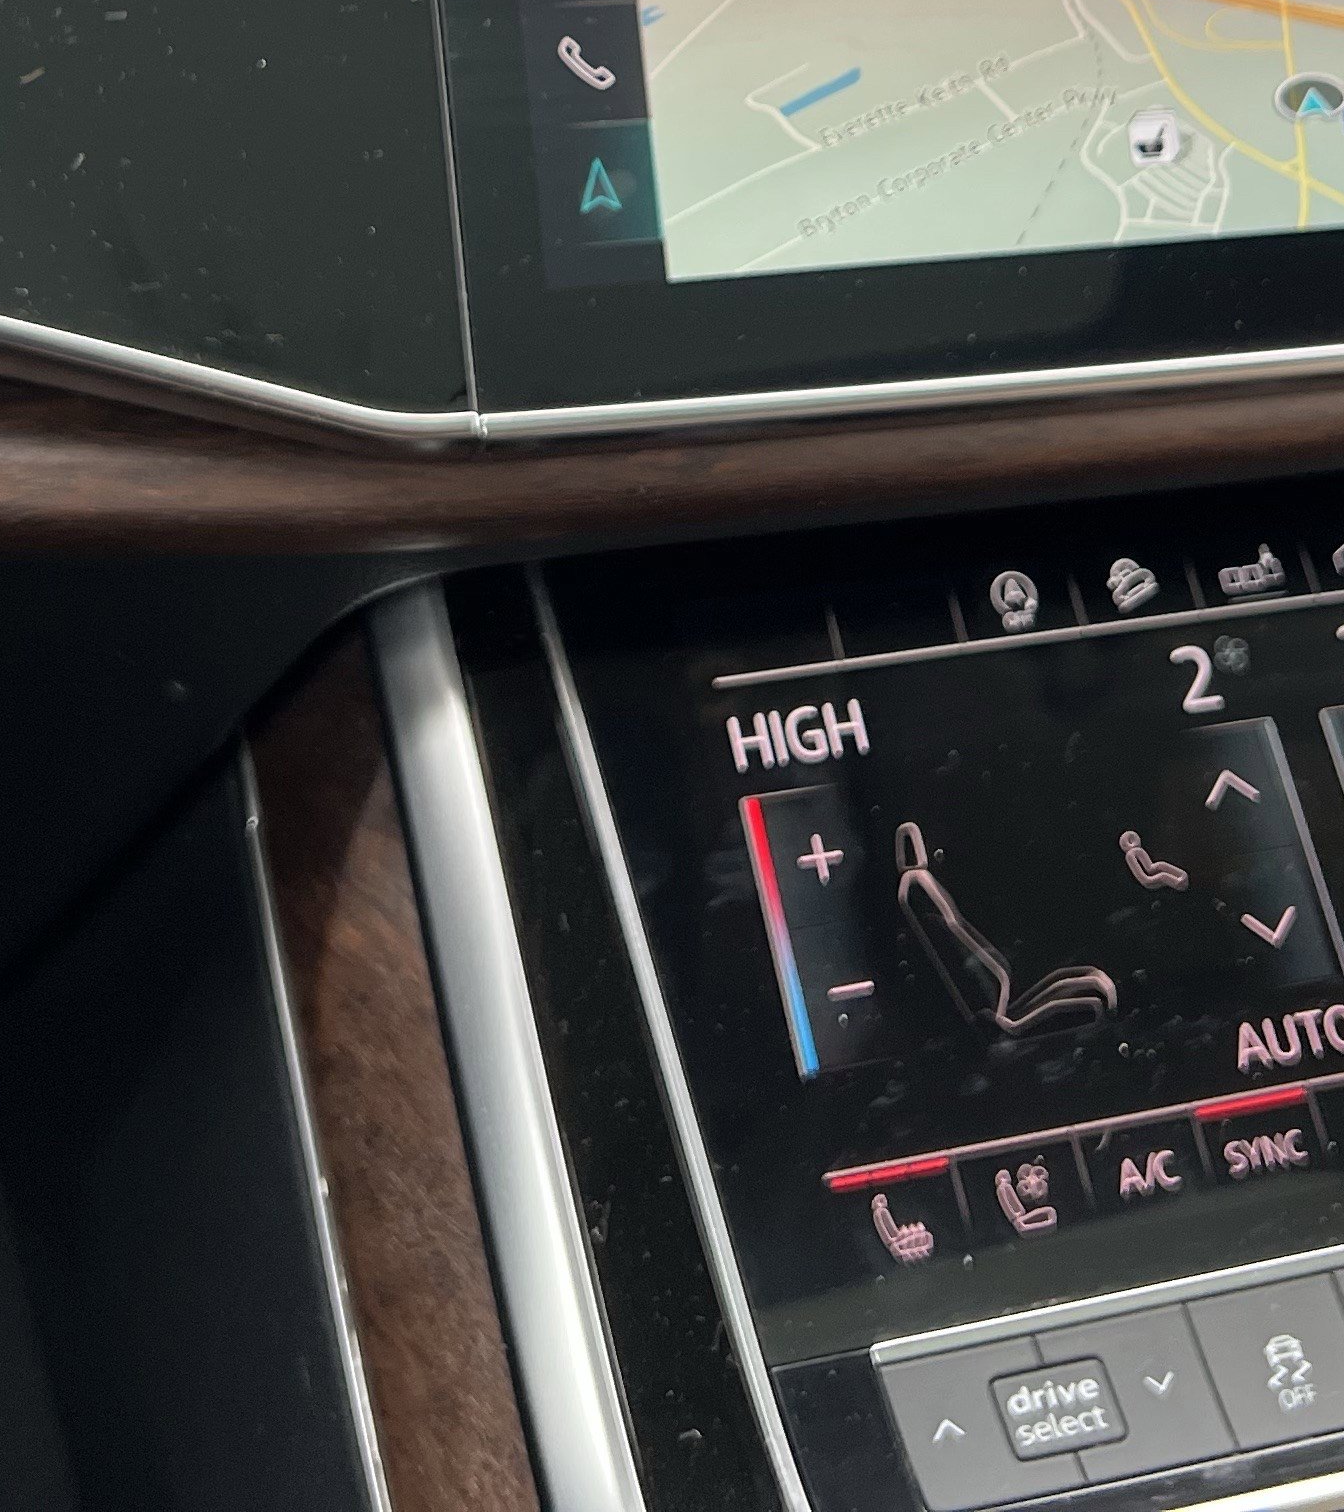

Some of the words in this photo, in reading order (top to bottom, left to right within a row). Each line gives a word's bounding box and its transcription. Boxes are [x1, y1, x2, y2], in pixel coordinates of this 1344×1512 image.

[876, 139, 983, 198] Corporate
[986, 101, 1055, 144] Center
[1169, 644, 1226, 715] 2
[726, 696, 870, 774] HIGH
[1117, 1148, 1182, 1200] A/C
[1222, 1127, 1310, 1181] SYNC
[1006, 1374, 1102, 1419] drive
[1277, 1381, 1318, 1413] OFF
[1012, 1404, 1111, 1449] select
